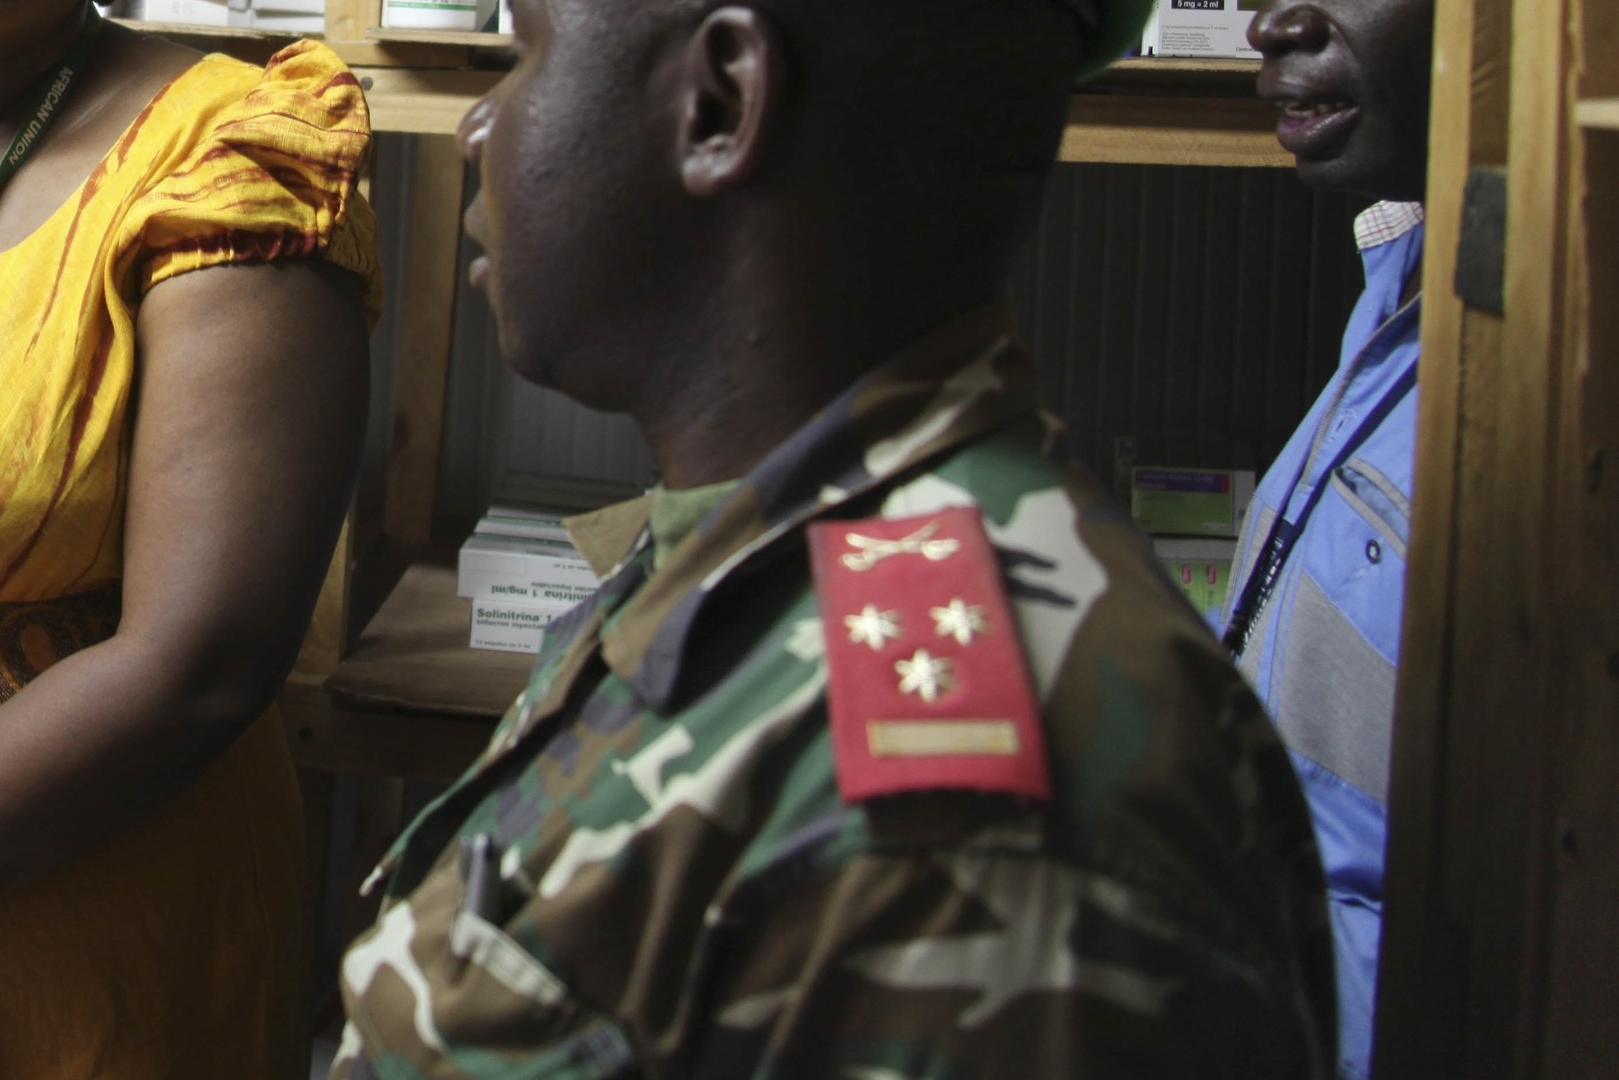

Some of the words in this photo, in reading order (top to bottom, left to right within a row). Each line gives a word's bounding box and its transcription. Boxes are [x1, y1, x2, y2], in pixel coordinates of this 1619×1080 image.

[1177, 0, 1182, 8] 5
[1183, 0, 1196, 9] mg
[1203, 0, 1208, 8] 2
[1209, 0, 1219, 8] ml
[36, 66, 74, 123] AFRICAN
[8, 119, 42, 166] UNION
[491, 584, 528, 596] mg/ml
[477, 608, 540, 623] Solinitrina
